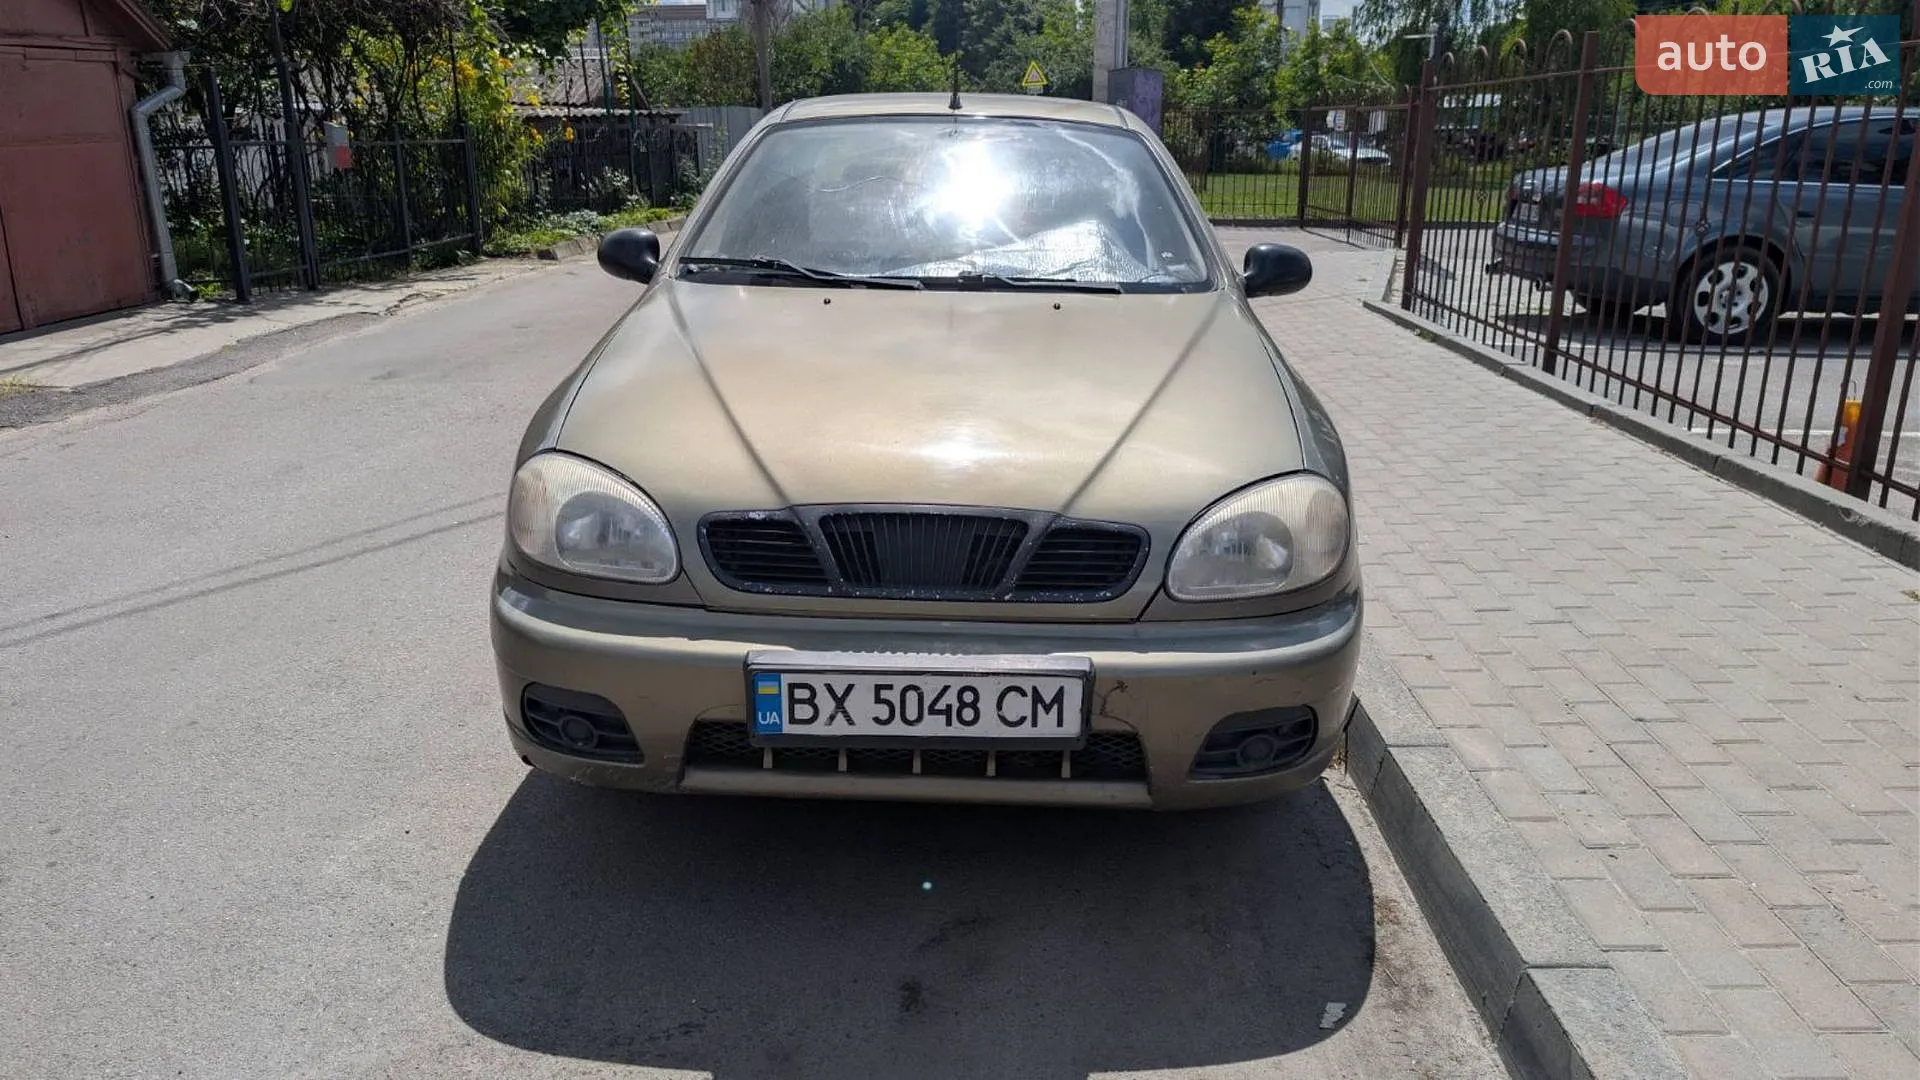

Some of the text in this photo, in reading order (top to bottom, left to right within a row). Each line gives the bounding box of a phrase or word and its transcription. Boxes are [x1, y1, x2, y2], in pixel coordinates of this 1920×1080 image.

[758, 711, 780, 725] UA
[787, 682, 1065, 728] BX 5048 CM
